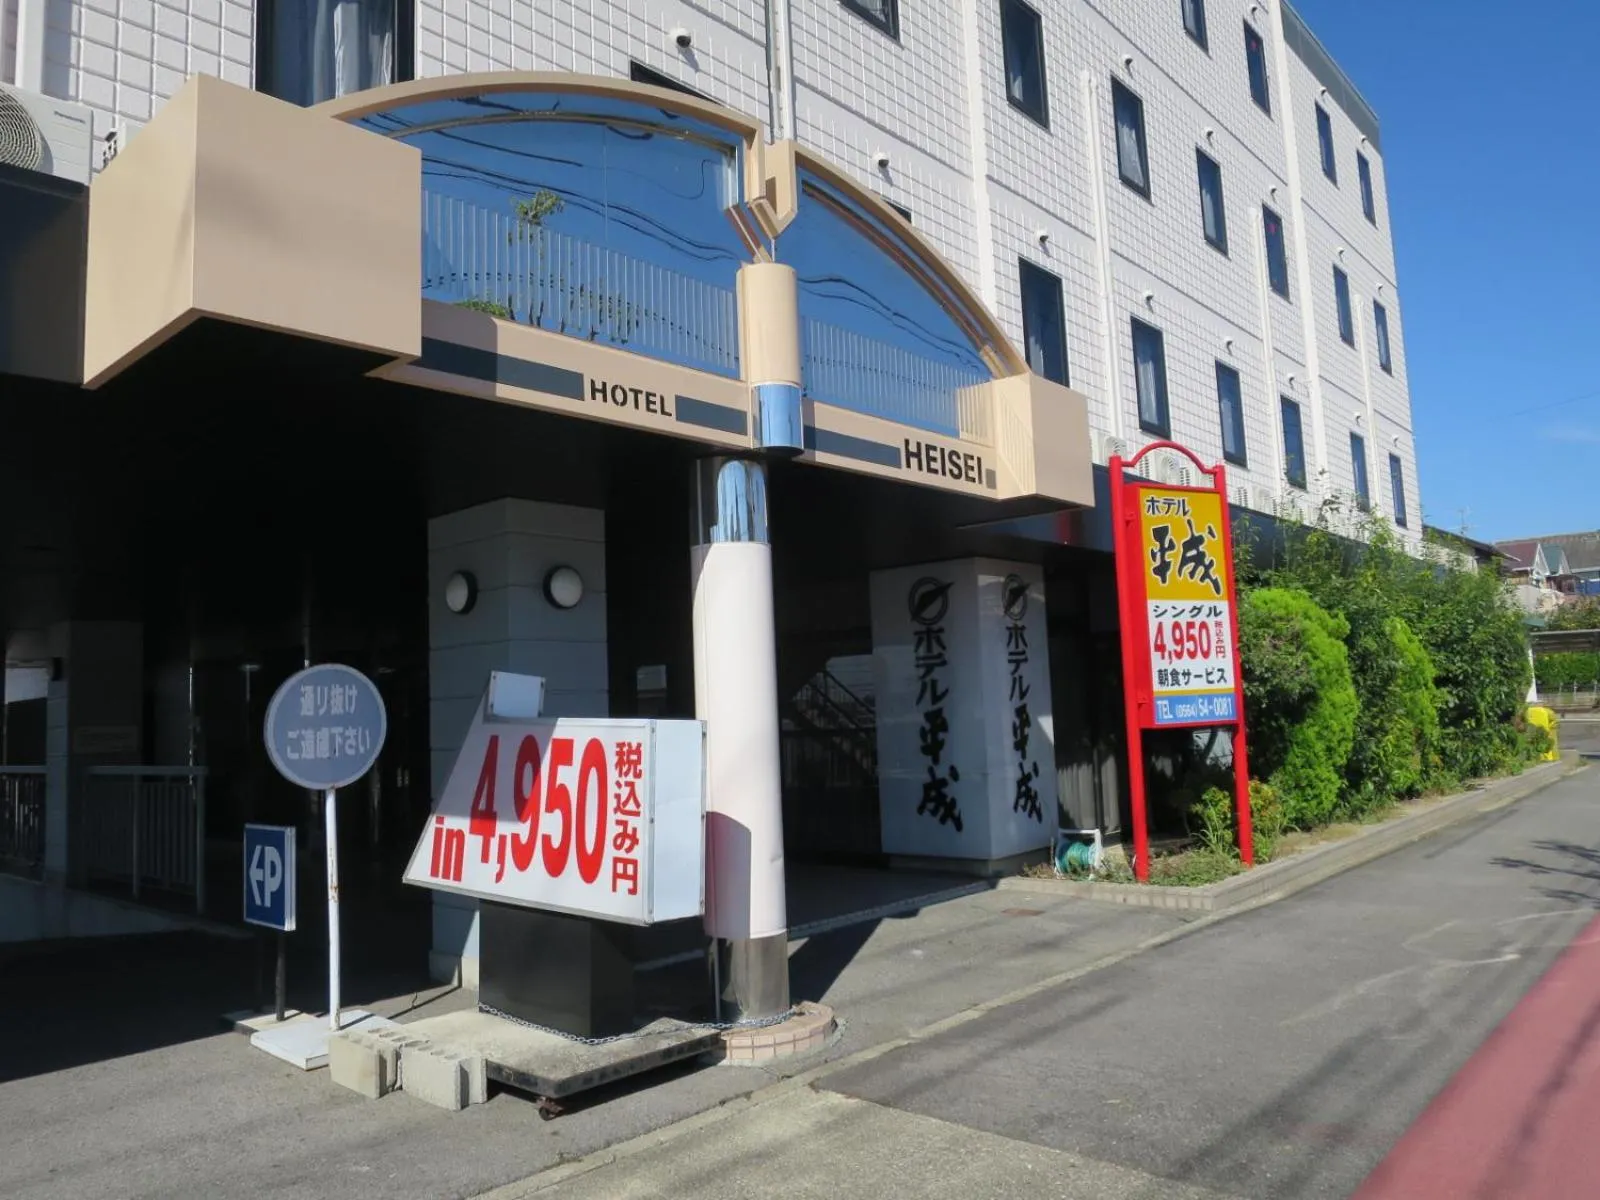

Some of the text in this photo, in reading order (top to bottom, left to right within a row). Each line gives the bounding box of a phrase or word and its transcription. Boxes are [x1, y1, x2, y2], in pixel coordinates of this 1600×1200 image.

[589, 378, 673, 418] HOTEL
[903, 437, 984, 486] HEISEI
[1145, 495, 1190, 516] ホテル
[1150, 519, 1222, 596] 平成
[1153, 605, 1223, 619] シングル
[1153, 620, 1211, 665] 4,950
[1157, 667, 1228, 687] 朝食サービス
[299, 683, 358, 717] 通り抜け
[1156, 699, 1174, 719] TEL
[286, 726, 371, 760] ご遠慮下さい
[429, 733, 608, 885] in 4,950
[610, 741, 644, 896] 税込み円
[263, 845, 283, 909] P
